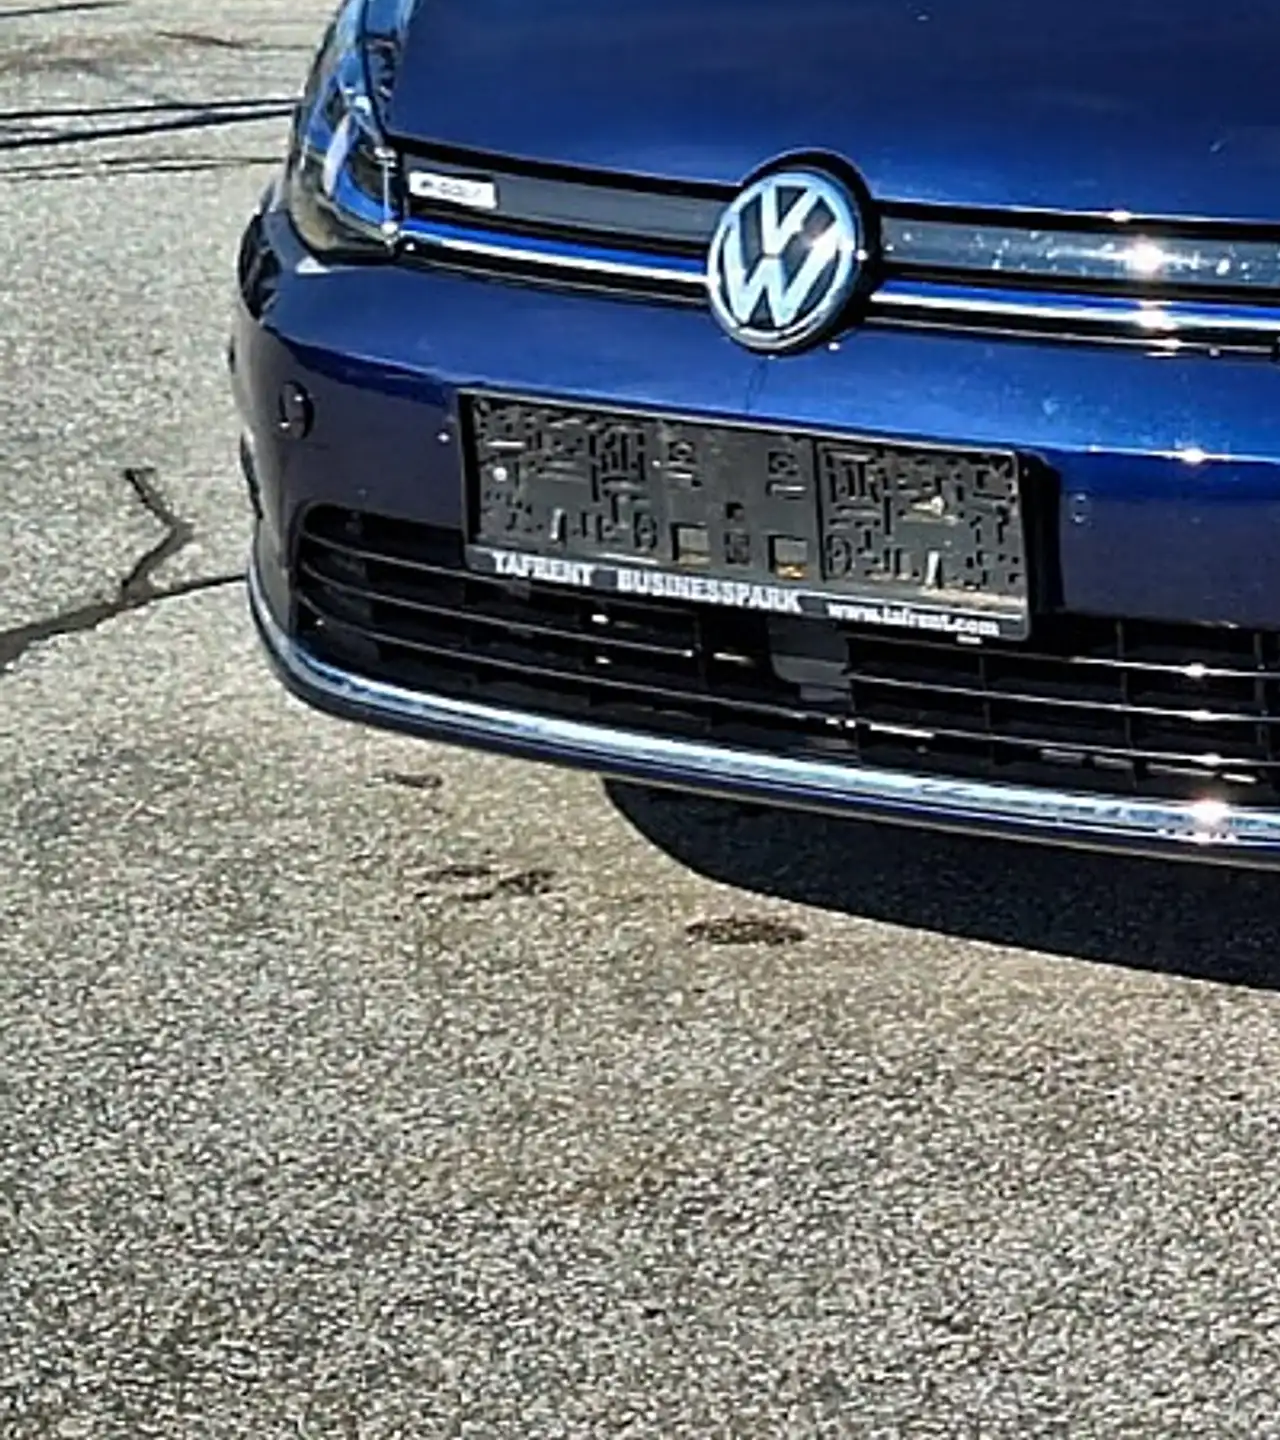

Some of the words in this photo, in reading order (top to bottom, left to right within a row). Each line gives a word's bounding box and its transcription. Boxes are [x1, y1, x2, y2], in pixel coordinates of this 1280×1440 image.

[491, 551, 595, 587] TAFRENT
[616, 567, 804, 612] BUSINESSPARK
[826, 602, 1000, 637] www.tafrent.com
